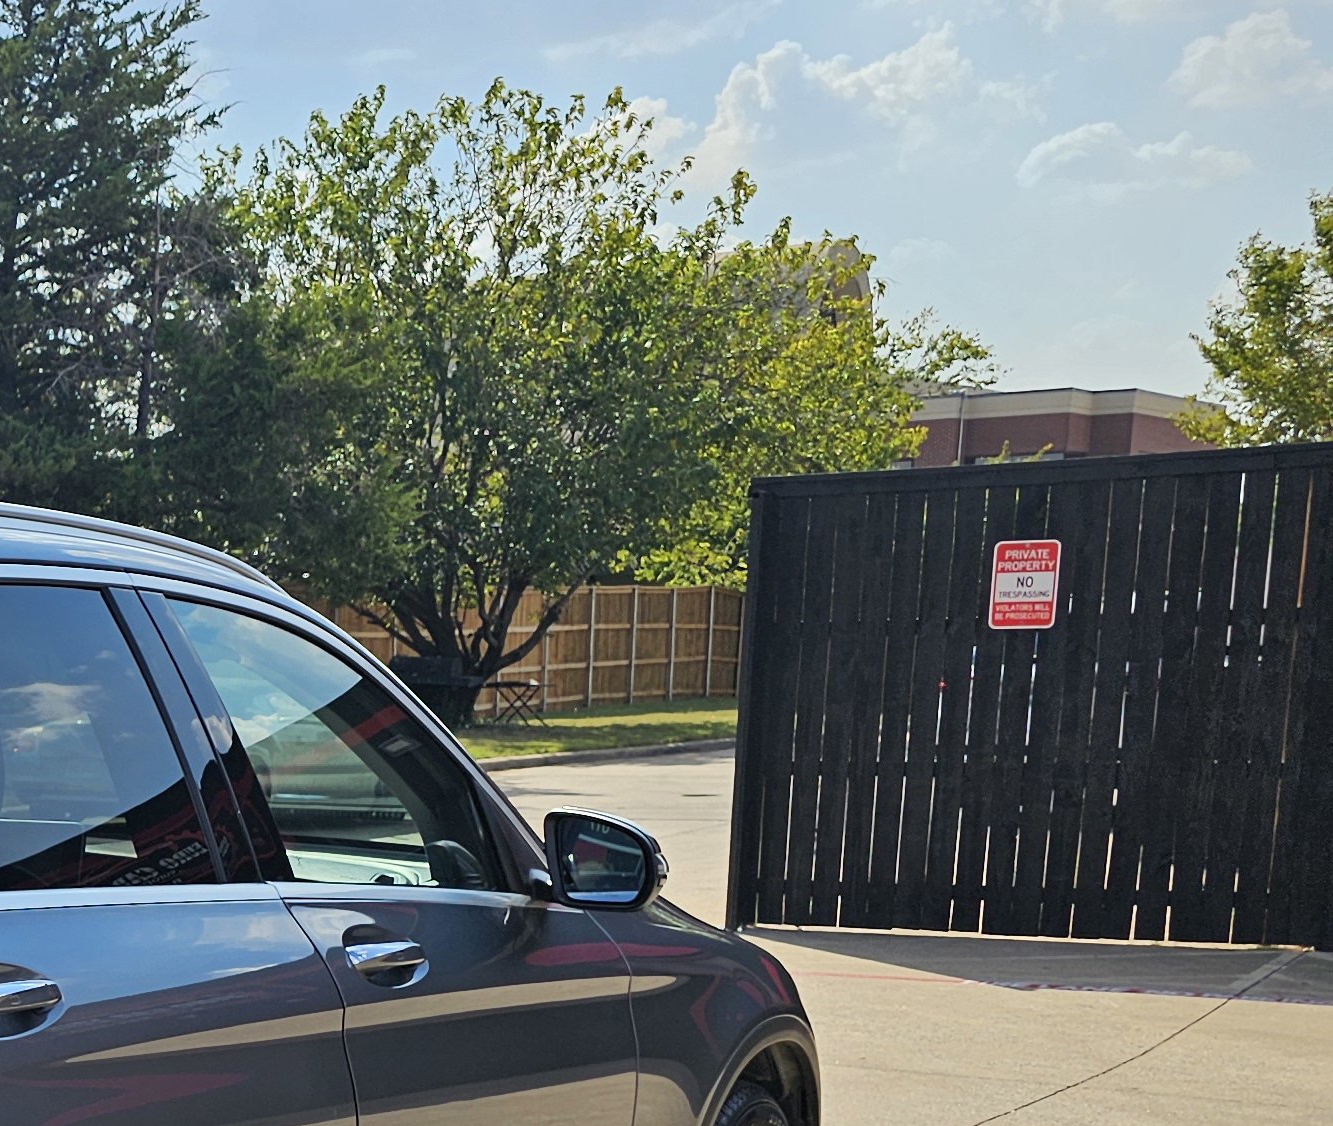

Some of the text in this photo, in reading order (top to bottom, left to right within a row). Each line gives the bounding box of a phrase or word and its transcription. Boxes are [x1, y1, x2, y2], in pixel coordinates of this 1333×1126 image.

[1005, 549, 1050, 559] PRIVATE
[997, 560, 1055, 571] PROPERTY
[1016, 576, 1034, 587] NO
[998, 589, 1050, 598] TRESPASSING
[994, 603, 1050, 611] VIOLATORS WILL
[994, 612, 1050, 620] BE PROSECUTED
